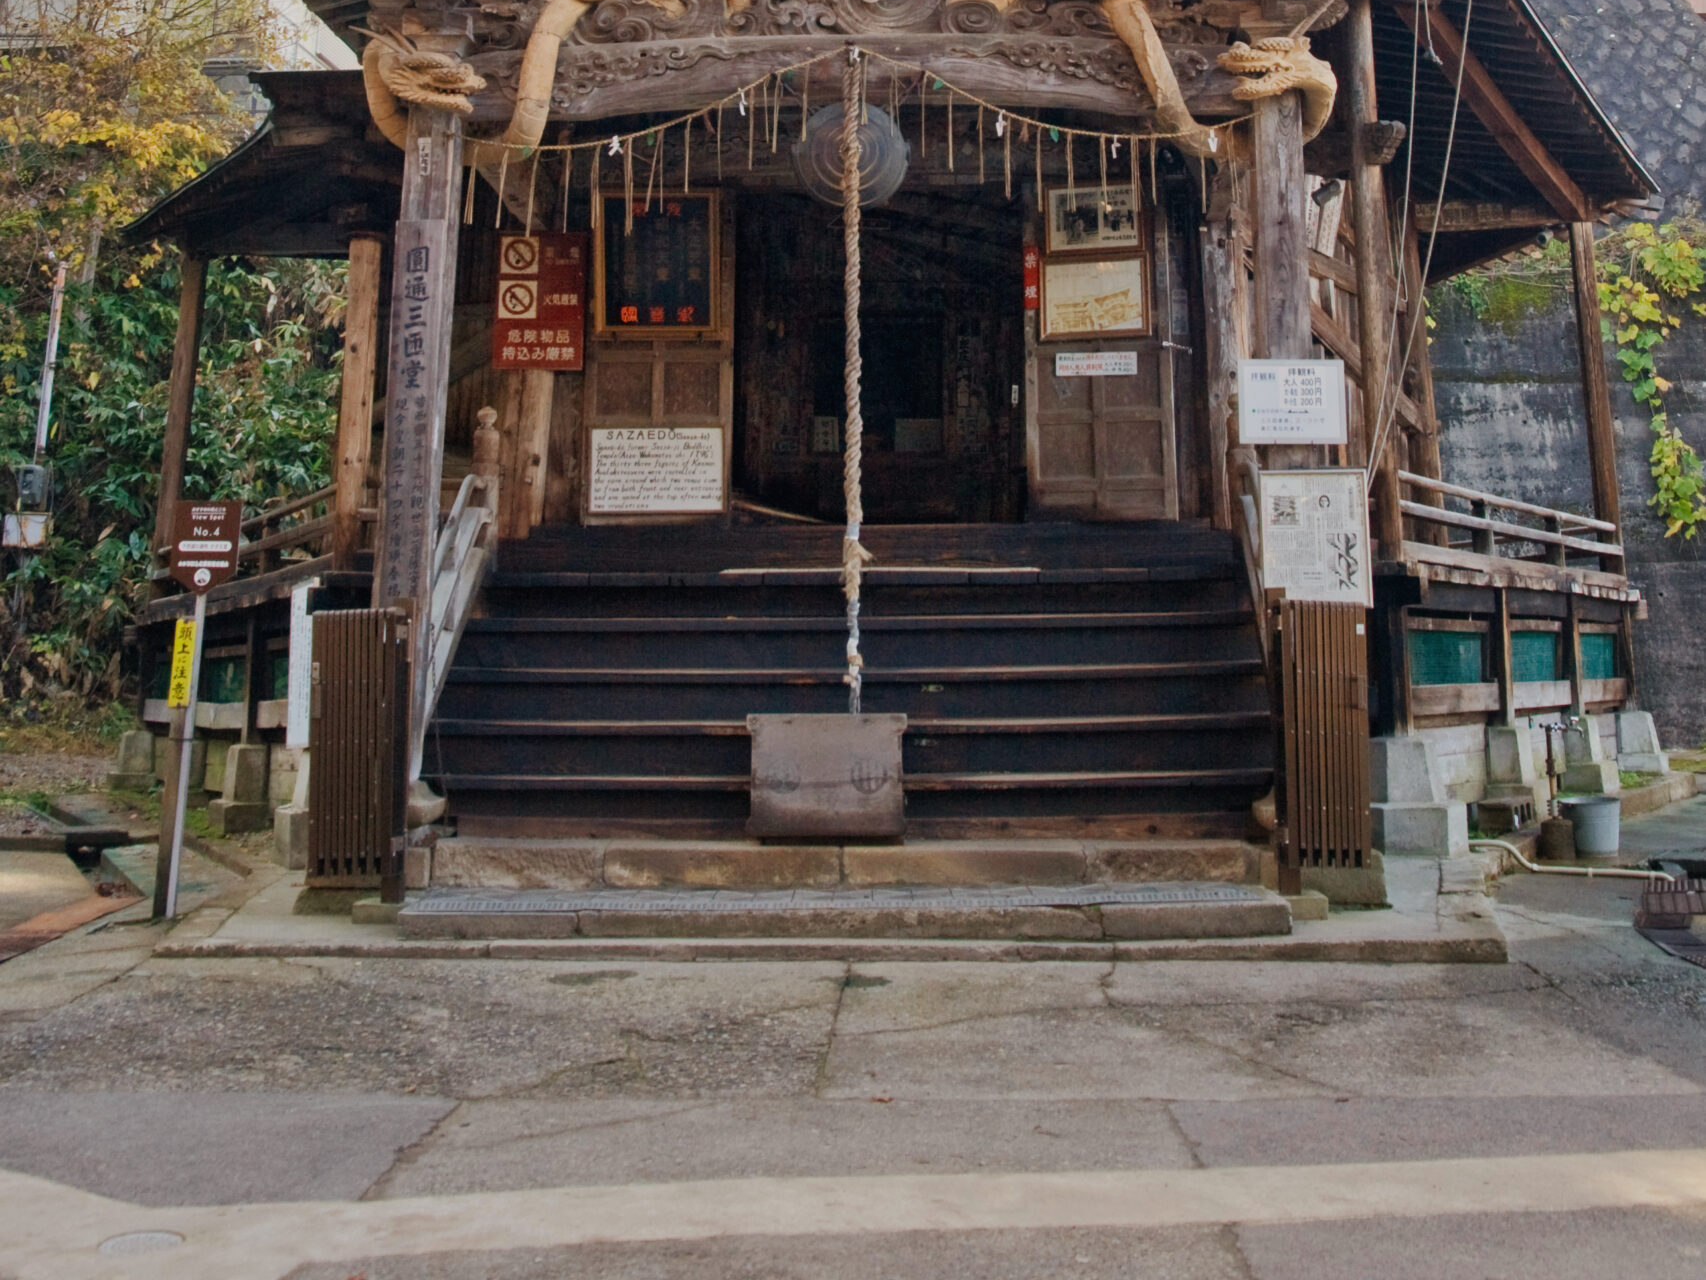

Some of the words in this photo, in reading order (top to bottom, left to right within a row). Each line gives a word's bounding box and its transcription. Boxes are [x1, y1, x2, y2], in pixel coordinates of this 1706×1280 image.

[1024, 252, 1038, 299] 禁煙
[543, 294, 578, 306] 火気厳禁
[507, 329, 570, 344] 危険物品
[502, 346, 575, 360] 持込み厳禁
[1300, 378, 1322, 386] 400円
[1300, 388, 1322, 396] 300円
[1300, 397, 1322, 406] 200円
[606, 430, 676, 440] SAZAEDO
[193, 526, 220, 536] No.4
[172, 626, 193, 700] 頭上に注意
